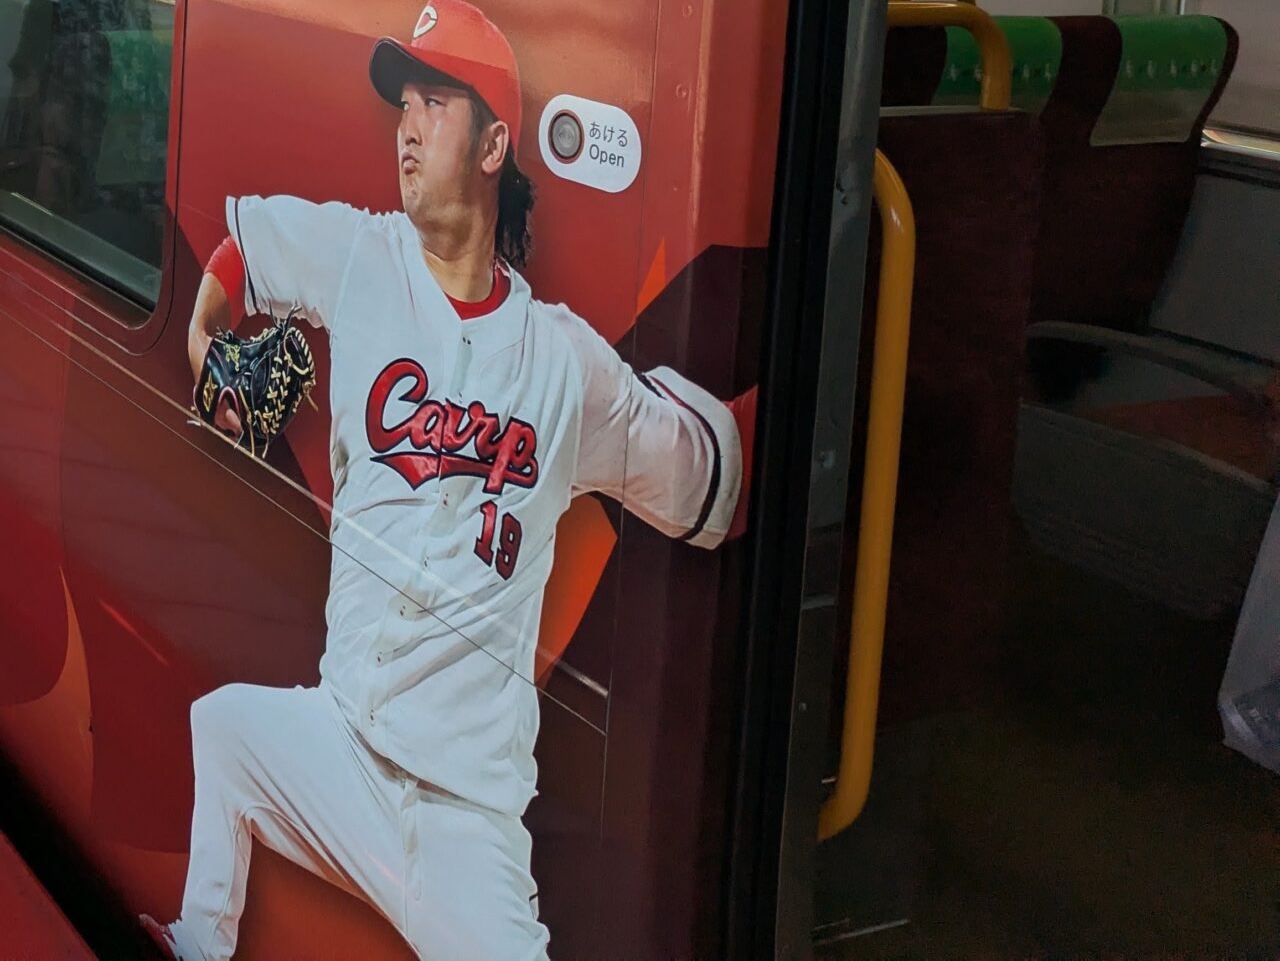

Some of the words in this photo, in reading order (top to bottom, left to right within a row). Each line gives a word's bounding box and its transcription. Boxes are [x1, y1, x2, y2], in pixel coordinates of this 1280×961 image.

[589, 121, 628, 147] あける
[589, 143, 625, 168] Open
[365, 357, 539, 495] Carp
[473, 499, 523, 581] 19
